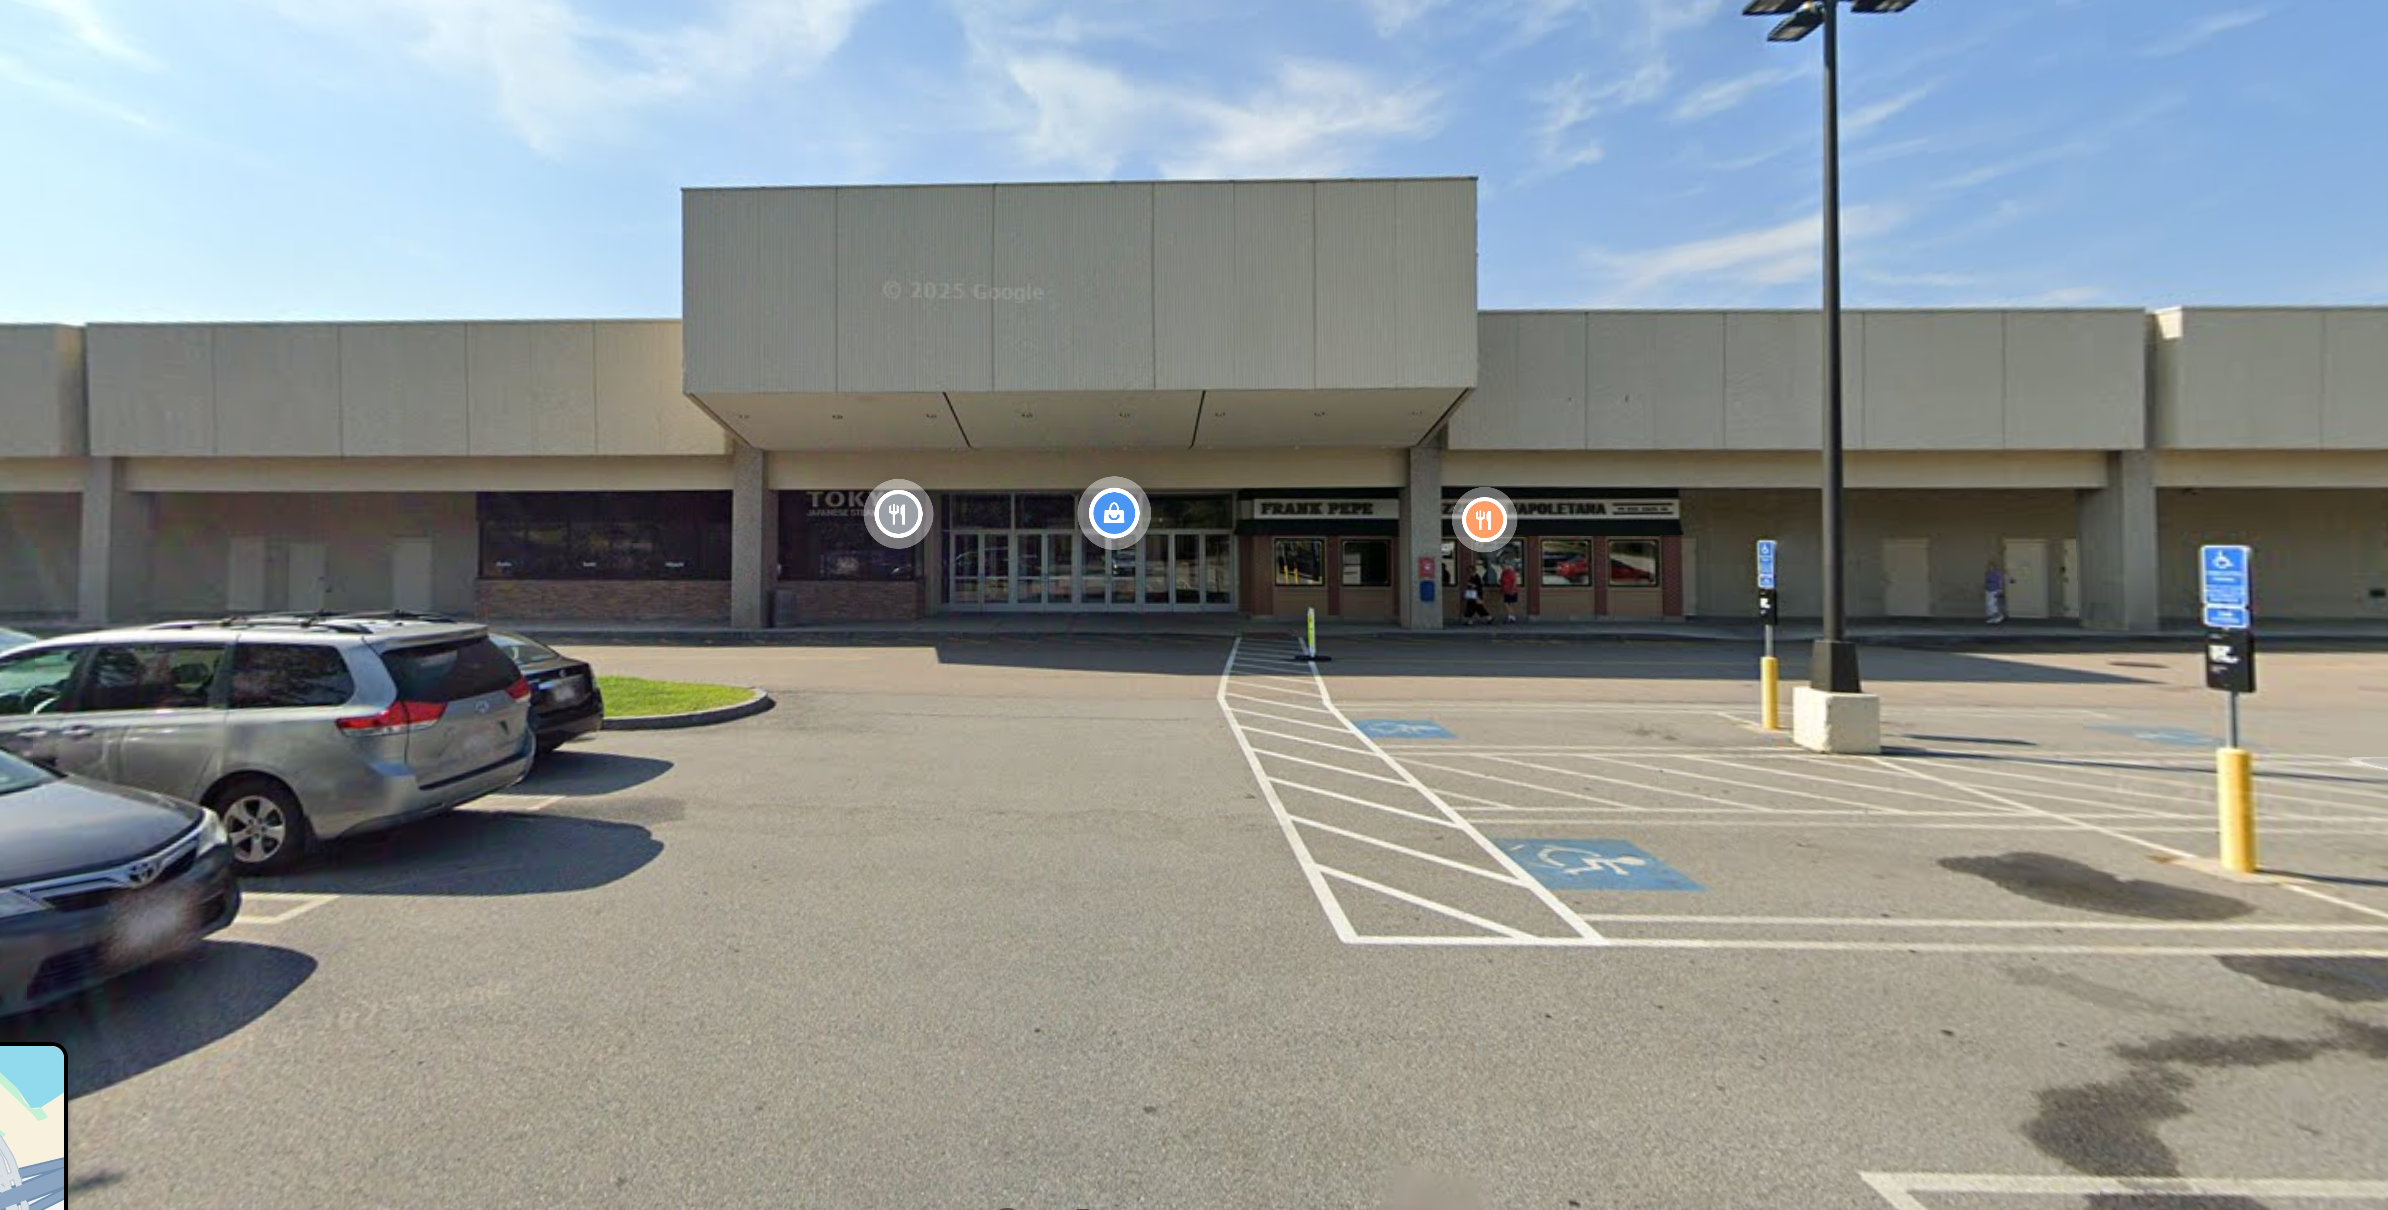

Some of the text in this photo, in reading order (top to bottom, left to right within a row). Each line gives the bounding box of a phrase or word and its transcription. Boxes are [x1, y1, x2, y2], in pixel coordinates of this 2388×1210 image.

[805, 491, 885, 508] TOKY
[806, 508, 875, 517] JAPANESE STEA
[1260, 502, 1374, 515] FRANK PEPE
[1507, 502, 1607, 516] NAPOLETANA
